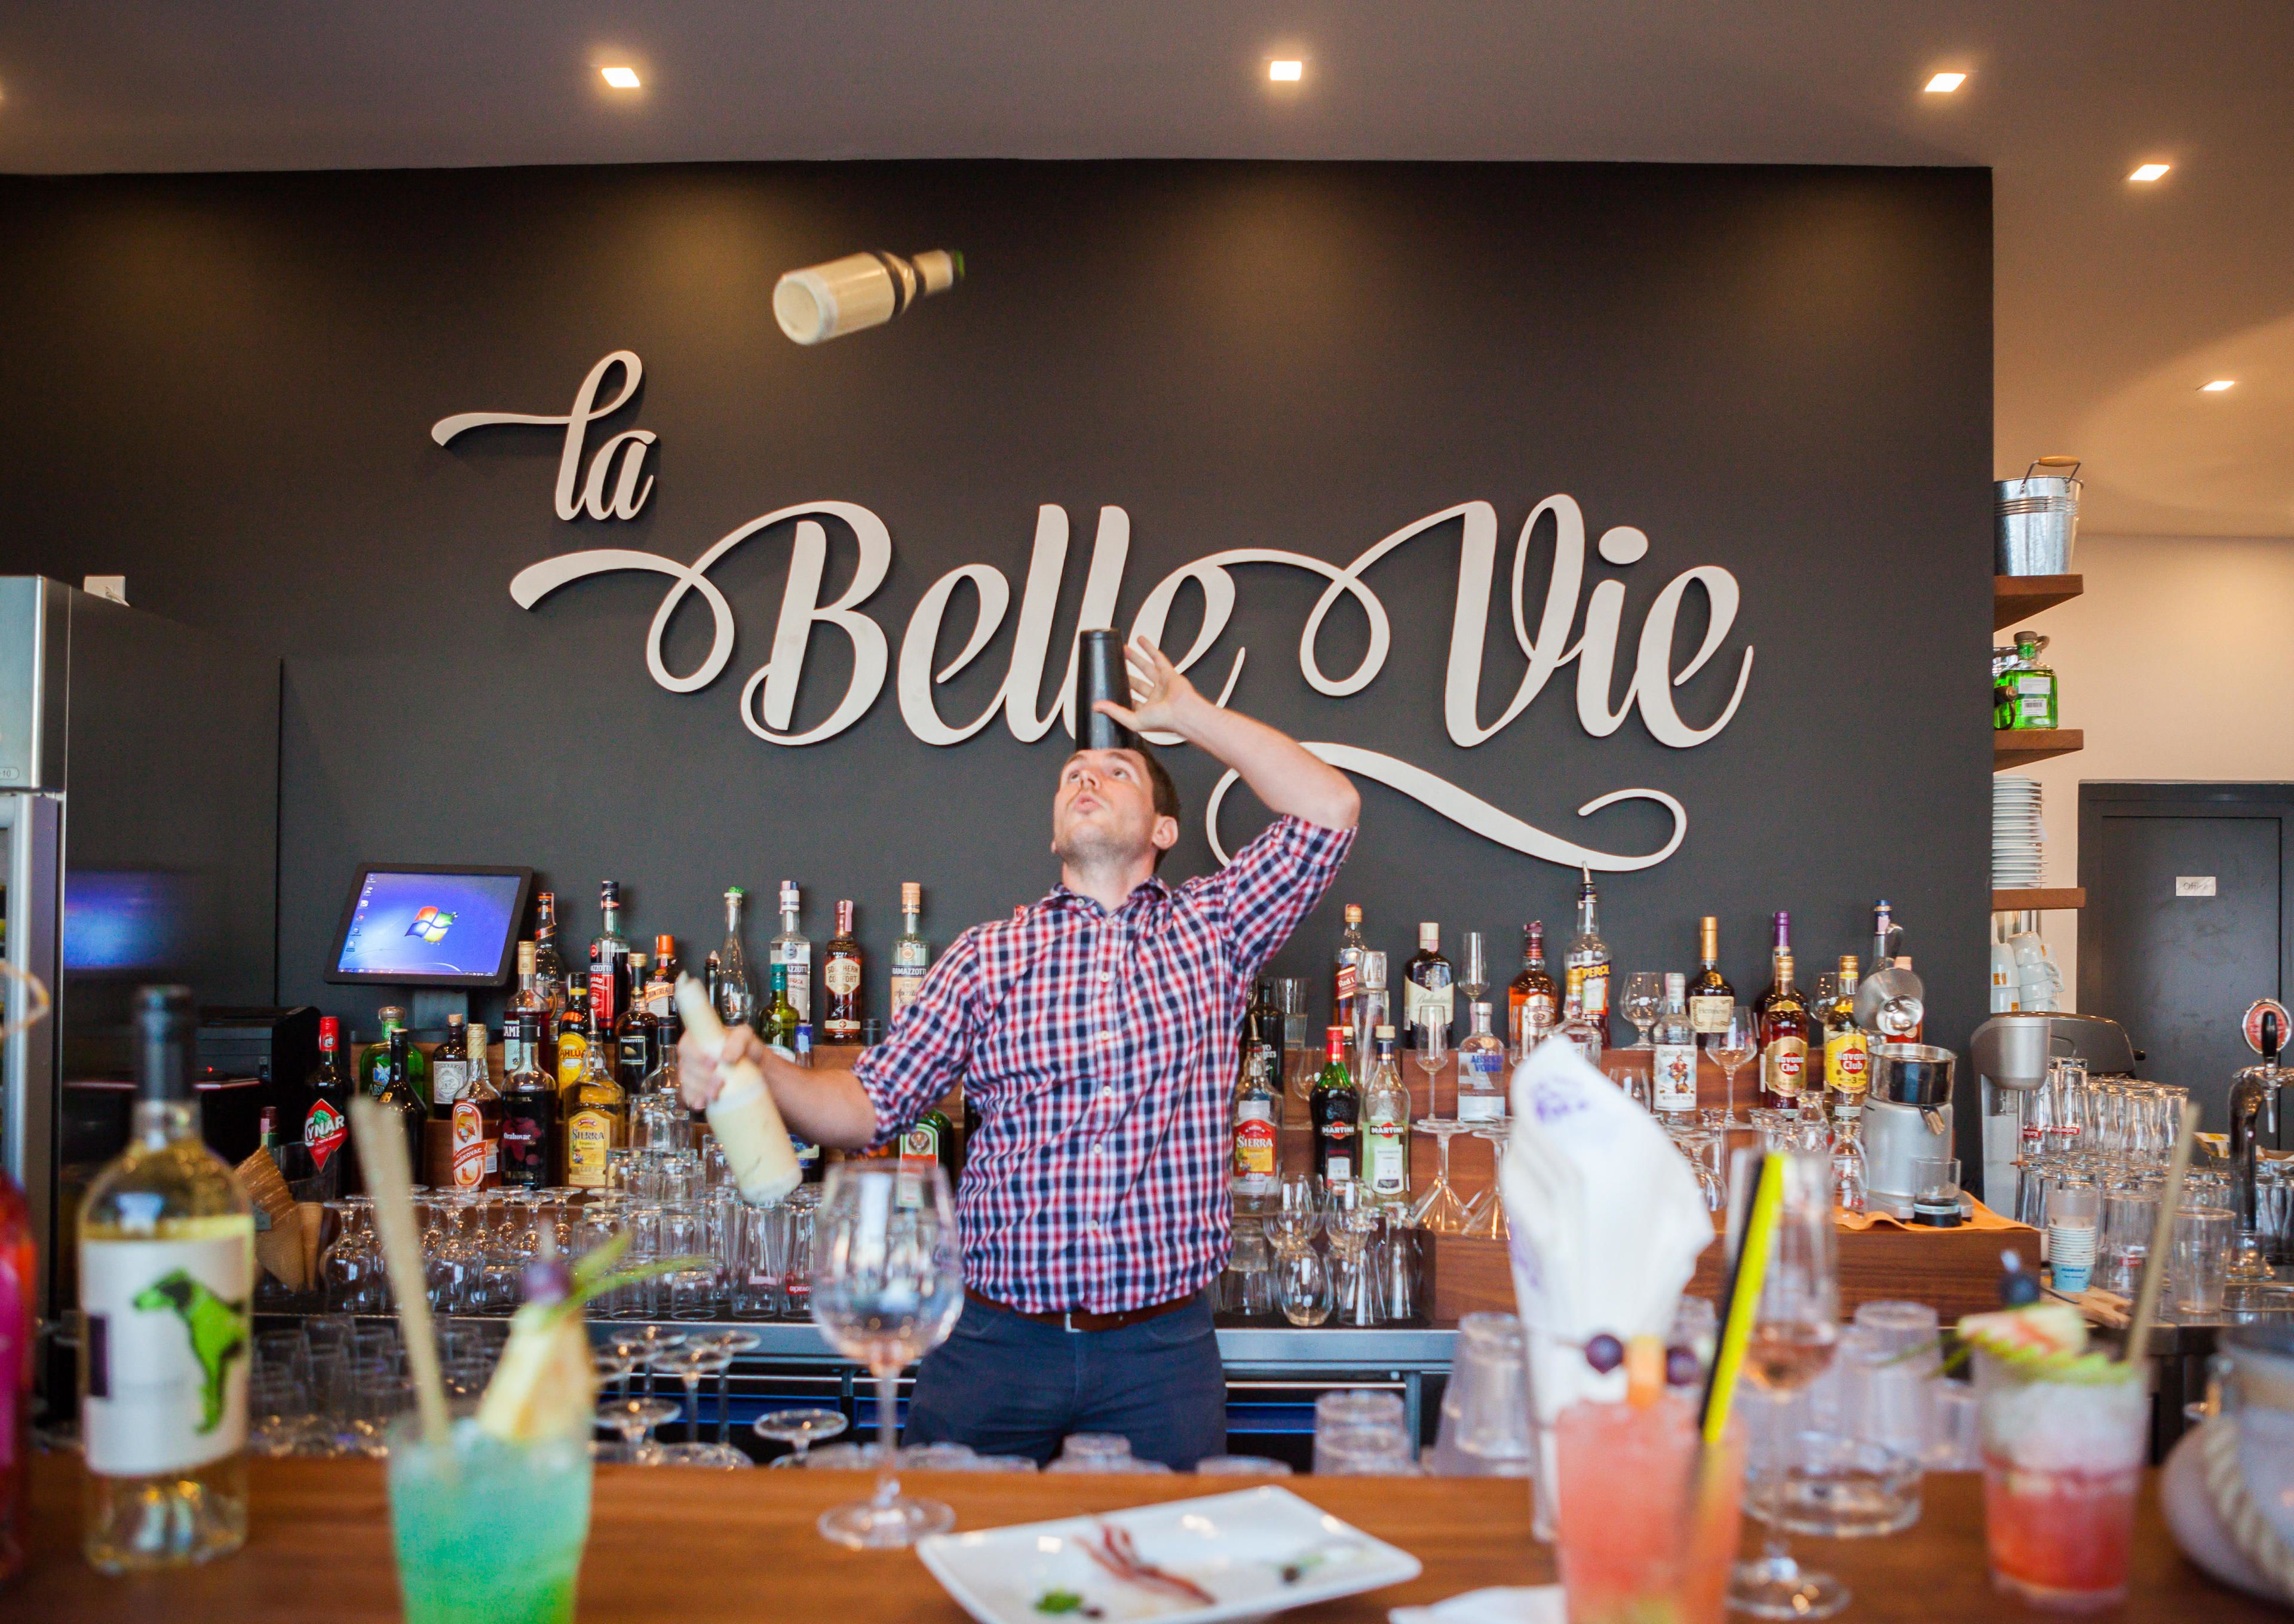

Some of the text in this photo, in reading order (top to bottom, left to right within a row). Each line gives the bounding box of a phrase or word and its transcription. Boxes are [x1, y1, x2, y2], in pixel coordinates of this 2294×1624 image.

[431, 351, 660, 522] la
[510, 493, 1755, 749] Belle Vie
[827, 965, 858, 974] SOHERN
[1582, 965, 1610, 979] PEROL
[1781, 1063, 1799, 1072] Club
[1842, 1061, 1863, 1070] Club
[305, 1115, 345, 1146] CYNAR
[572, 1128, 604, 1140] SIERRA
[1236, 1135, 1273, 1148] SIERRA
